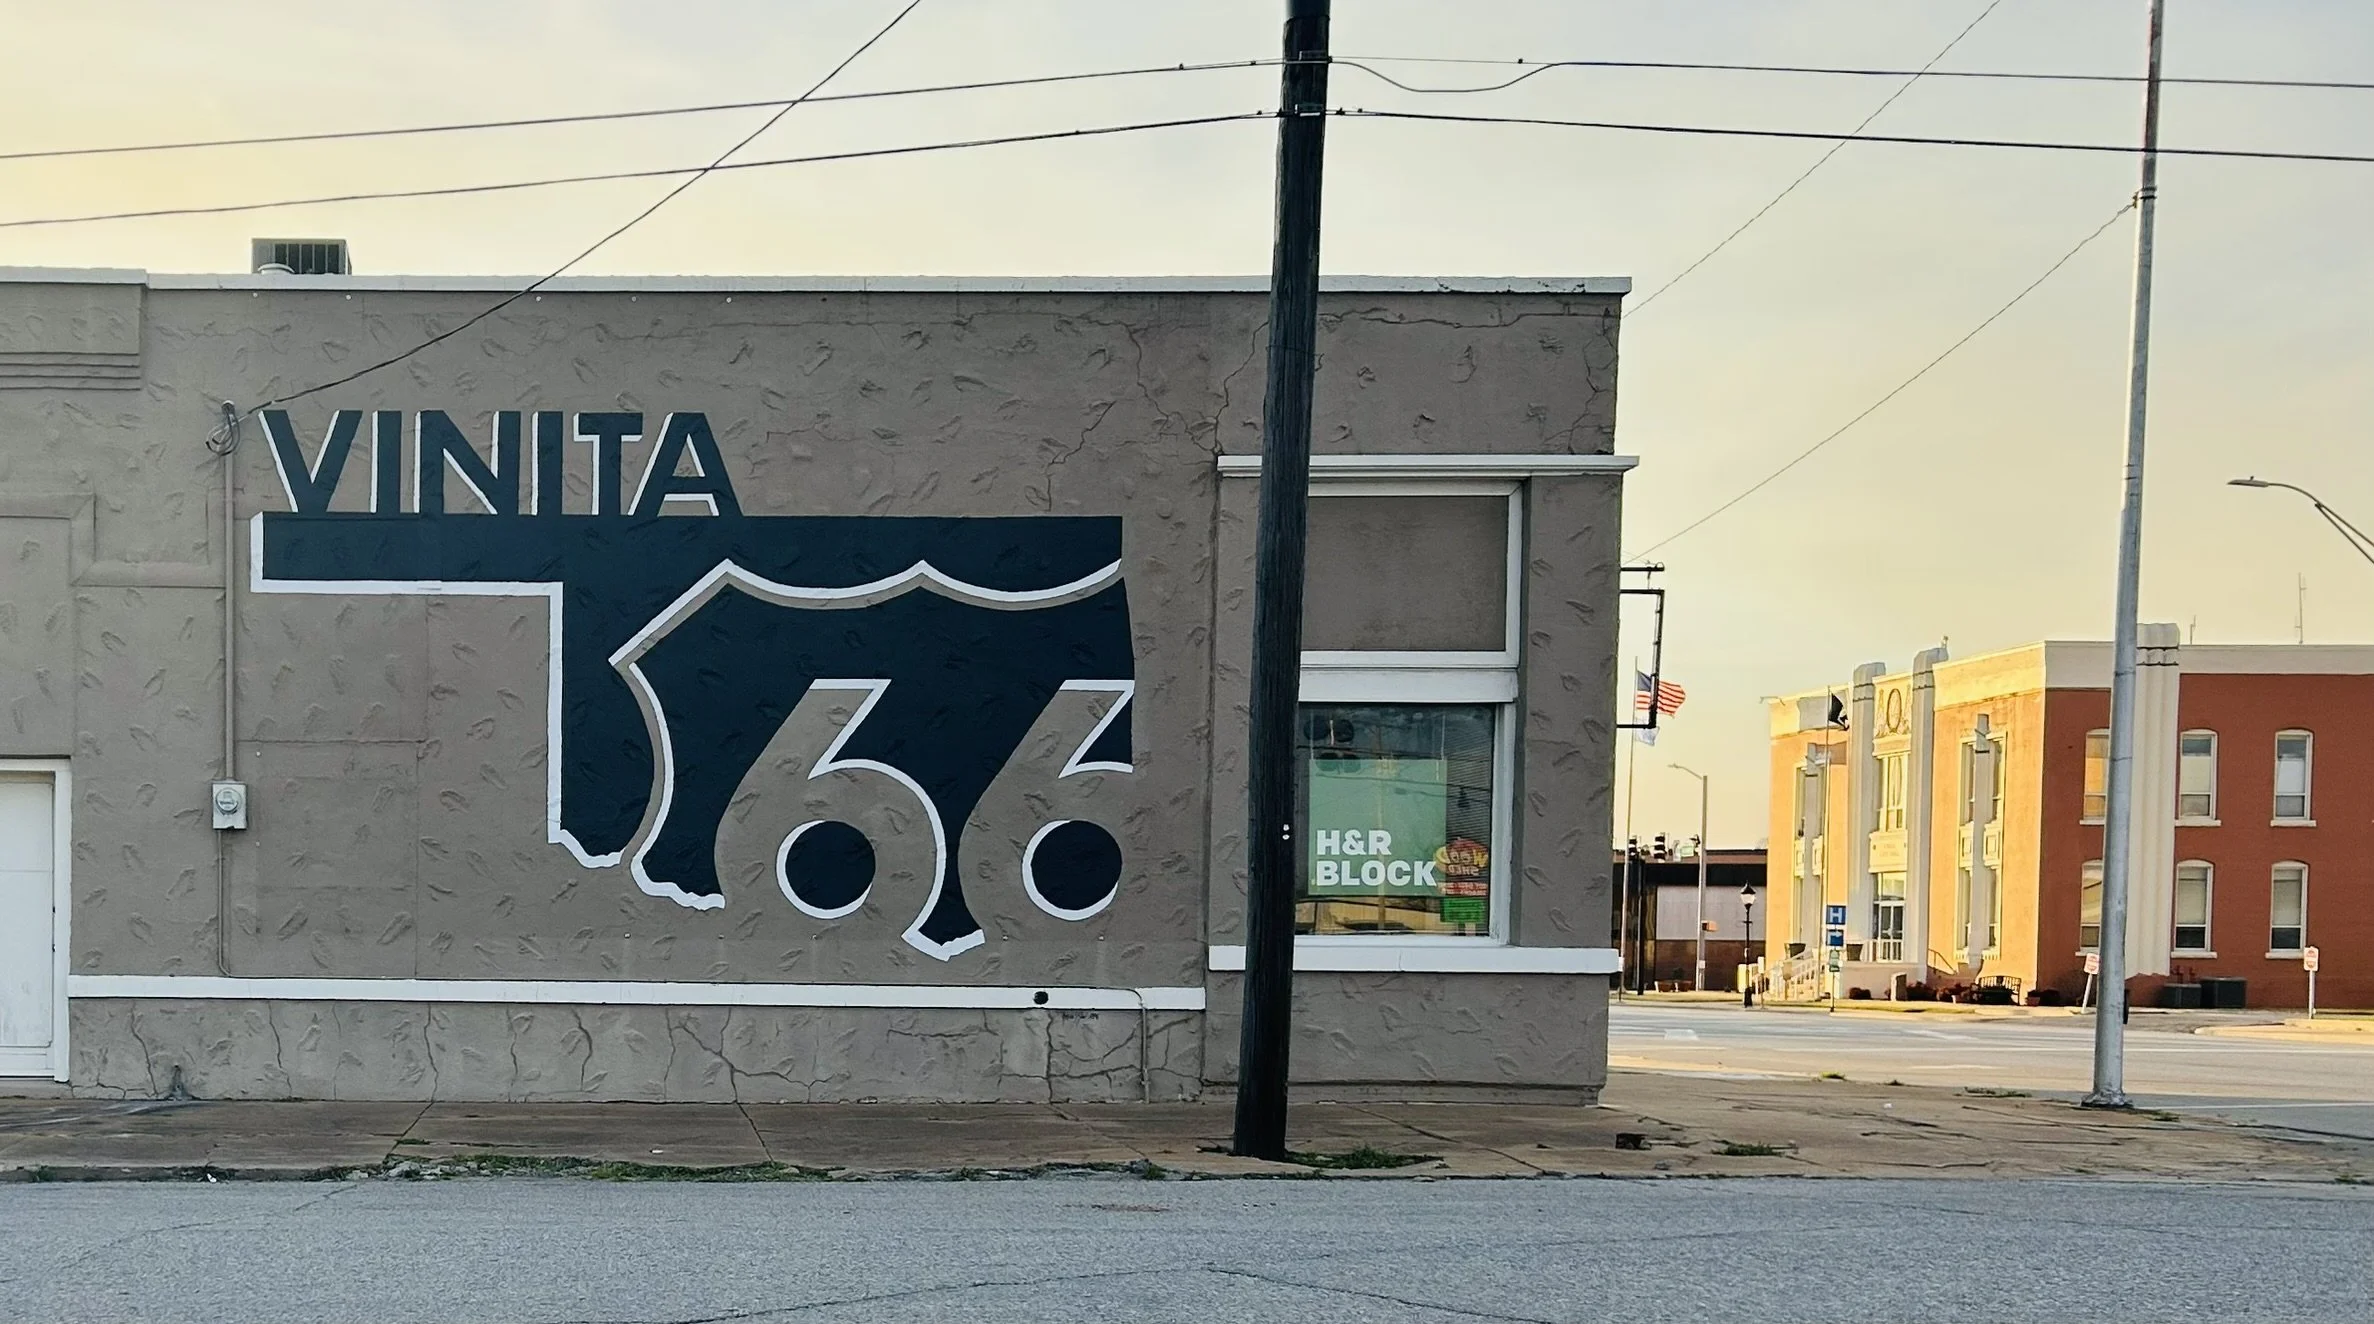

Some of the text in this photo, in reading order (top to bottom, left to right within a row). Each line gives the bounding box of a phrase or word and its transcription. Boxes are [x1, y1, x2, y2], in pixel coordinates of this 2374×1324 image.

[258, 409, 744, 516] VINITA
[714, 678, 1137, 945] 66
[1316, 829, 1392, 856] H&R
[1316, 860, 1437, 887] BLOCK
[1829, 907, 1843, 923] H
